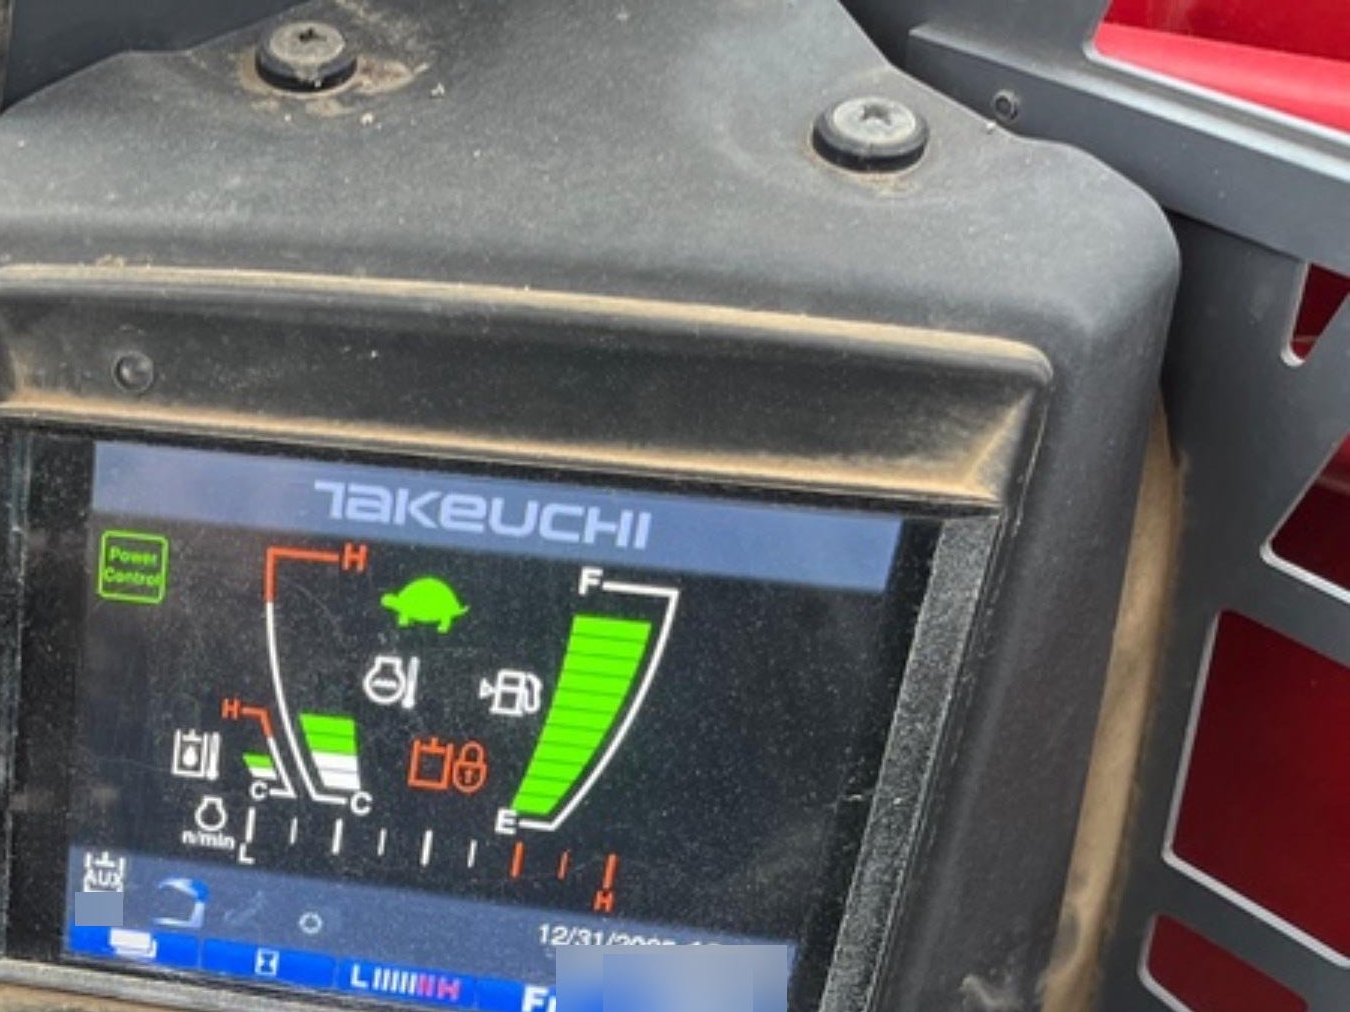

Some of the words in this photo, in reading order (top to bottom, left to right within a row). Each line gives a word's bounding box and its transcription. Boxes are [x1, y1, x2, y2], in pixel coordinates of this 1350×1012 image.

[314, 479, 652, 549] TAKEUCHI
[108, 545, 158, 566] Power
[341, 542, 369, 573] H
[102, 566, 165, 588] Control
[577, 566, 605, 596] F
[220, 697, 241, 720] H
[250, 780, 269, 801] C
[349, 790, 374, 816] C
[494, 807, 518, 835] E
[238, 842, 256, 865] L
[84, 868, 124, 889] AUX
[592, 890, 615, 914] H
